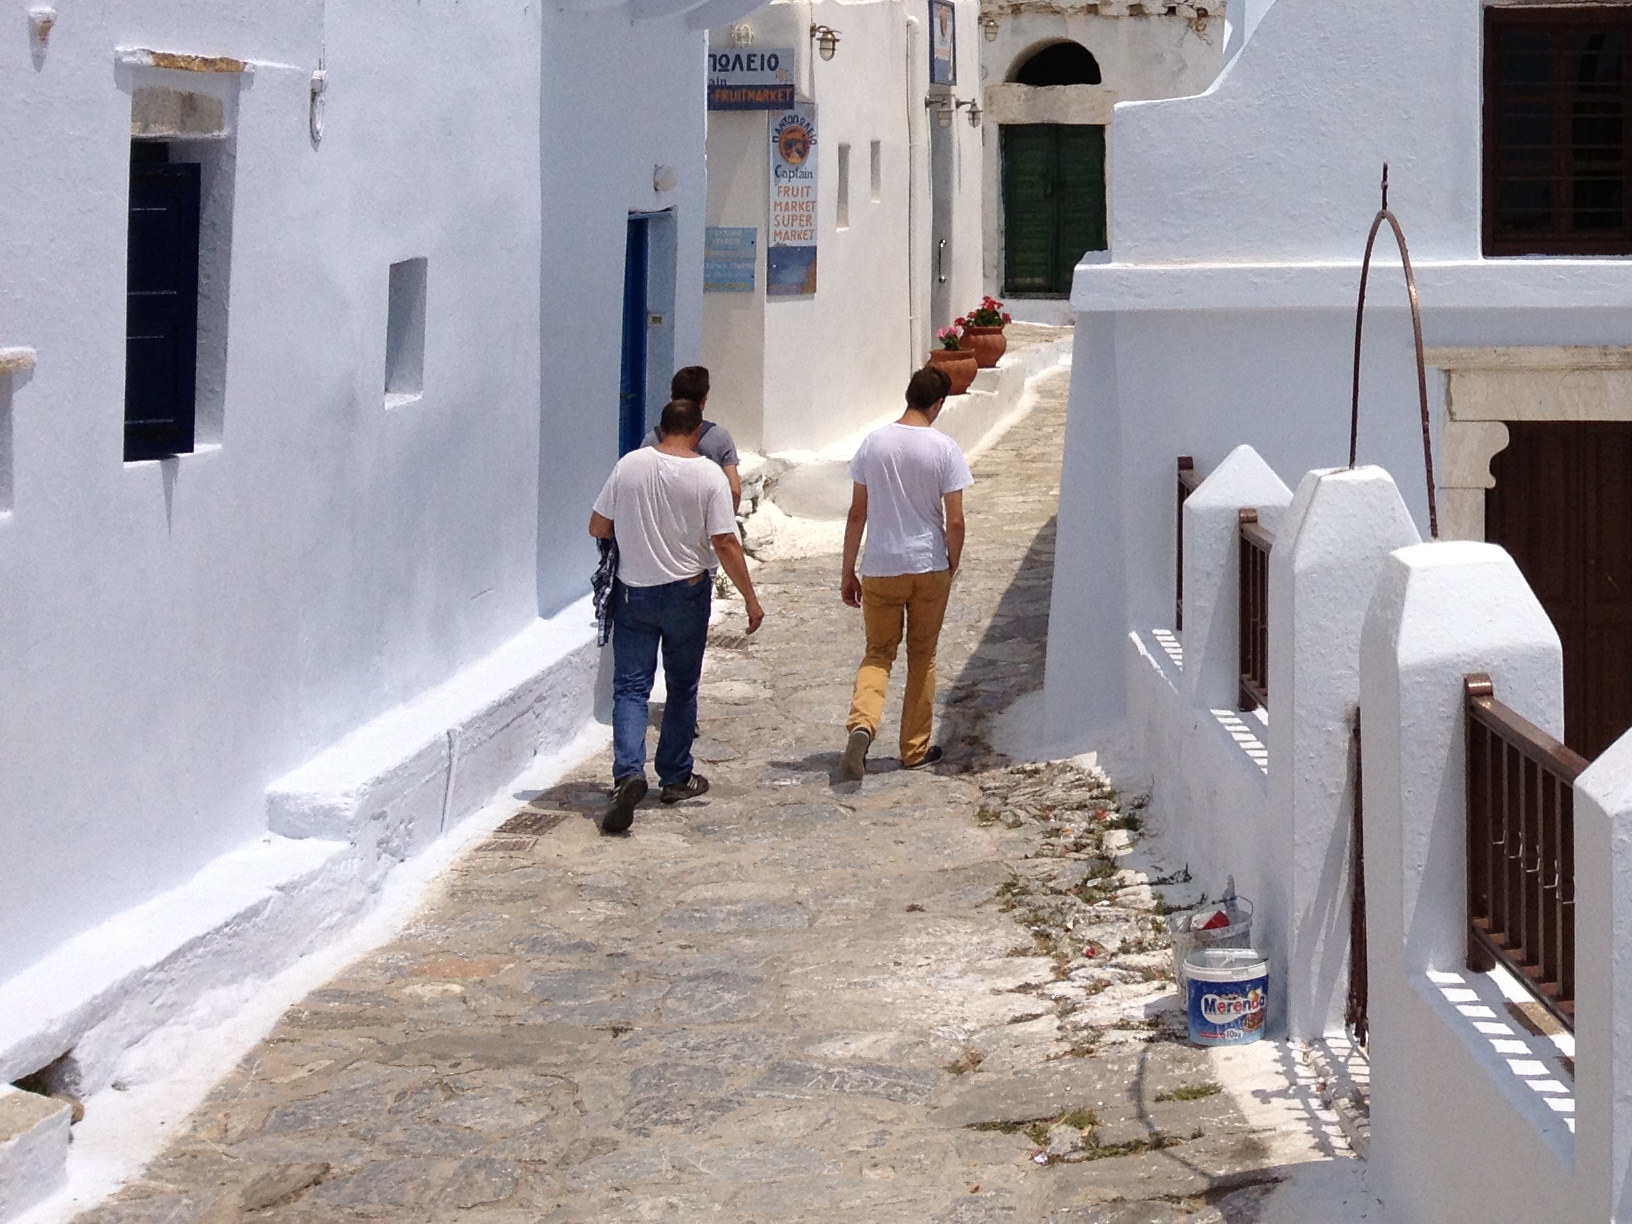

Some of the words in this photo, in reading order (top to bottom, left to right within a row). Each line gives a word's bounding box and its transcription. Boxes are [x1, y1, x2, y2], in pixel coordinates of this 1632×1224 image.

[774, 164, 813, 183] Captain
[777, 185, 812, 198] FRUIT
[773, 200, 817, 213] MARKET
[773, 214, 813, 228] SUPER
[773, 229, 815, 243] MARKET
